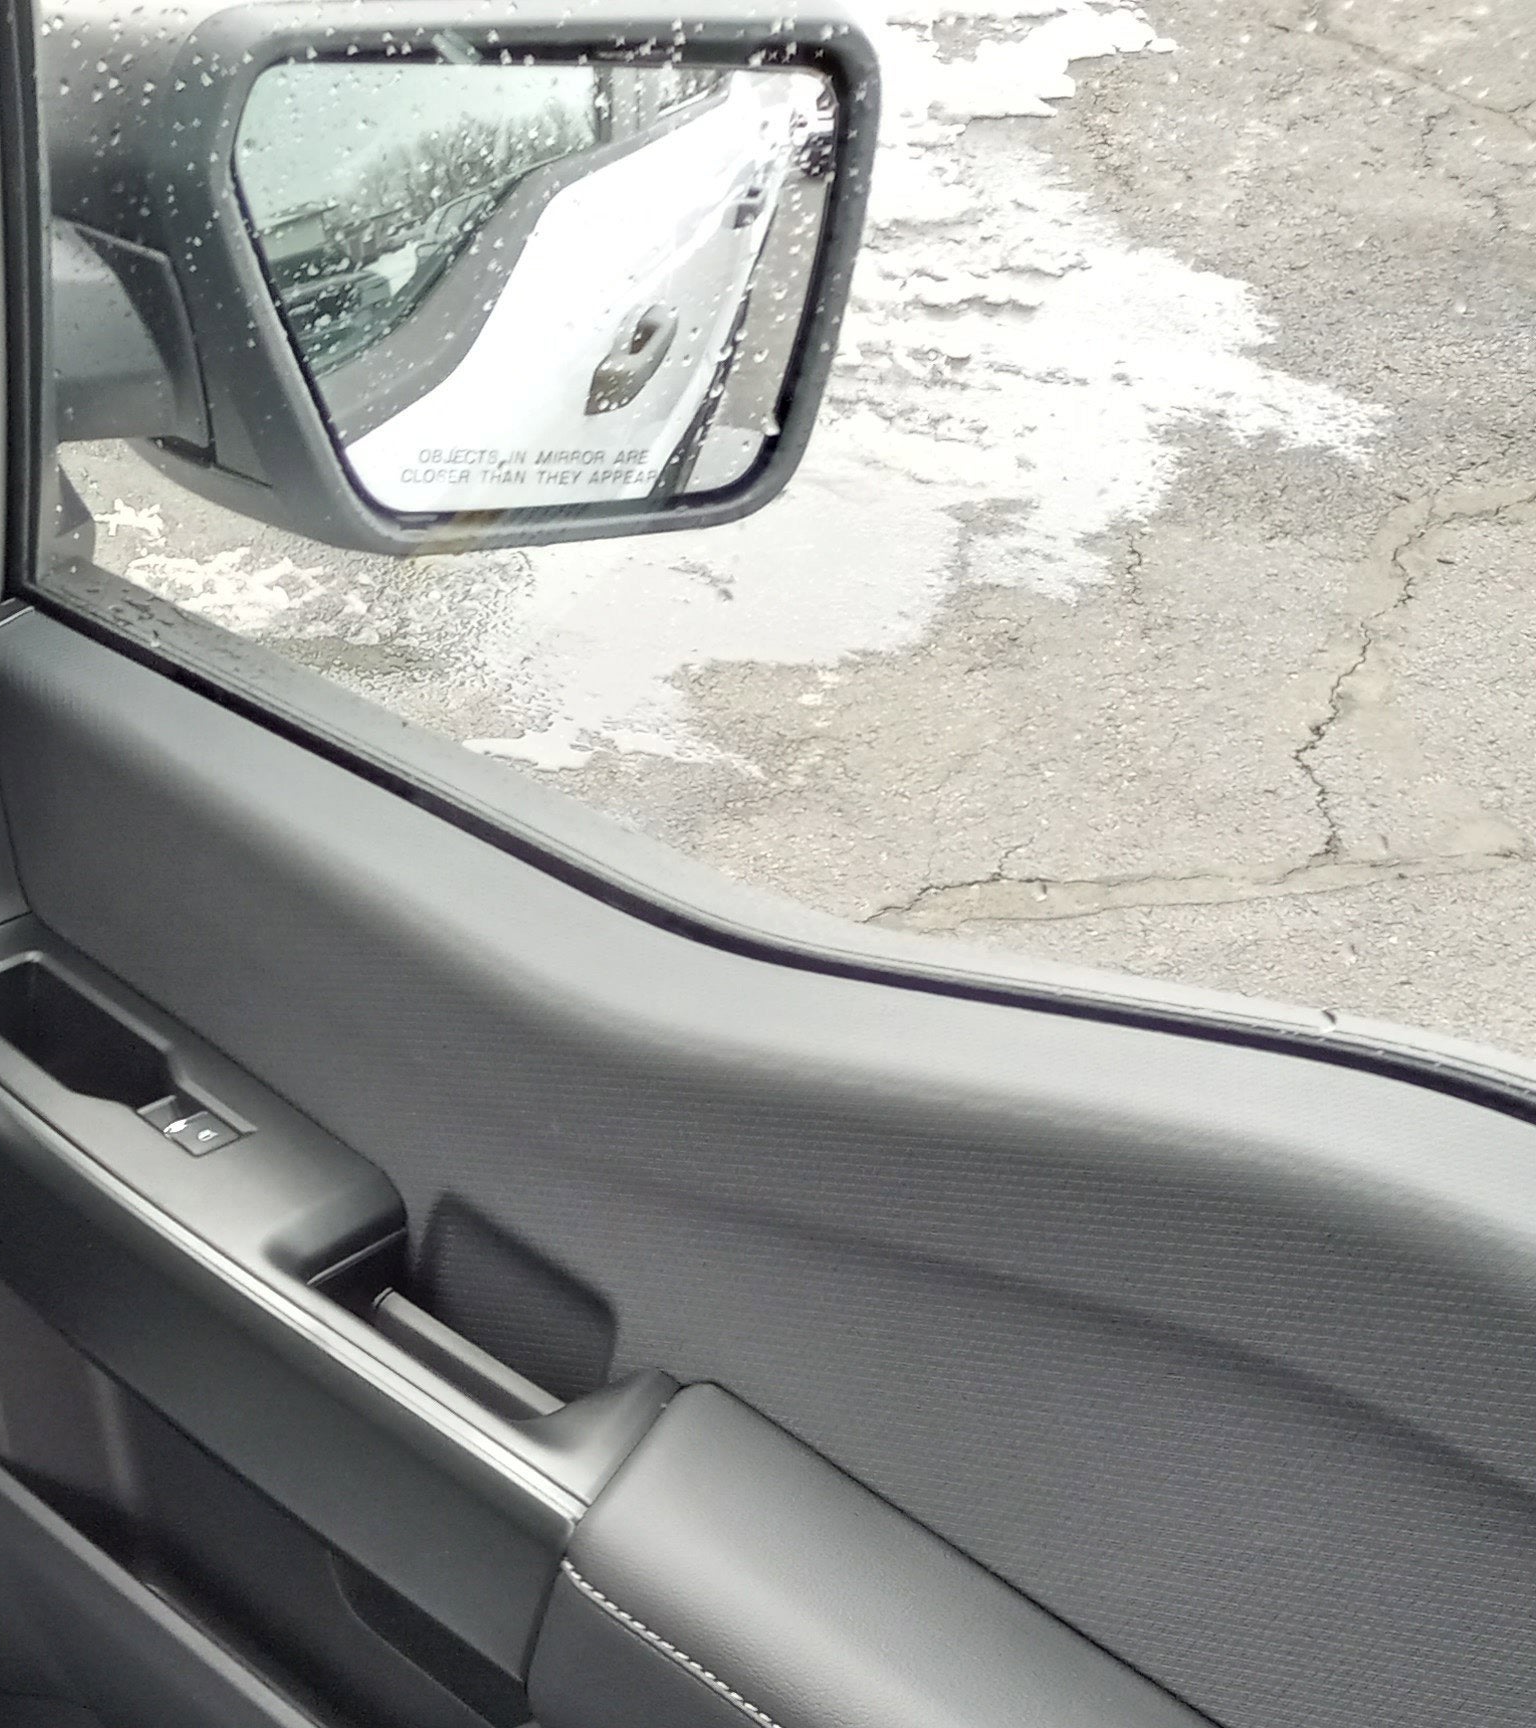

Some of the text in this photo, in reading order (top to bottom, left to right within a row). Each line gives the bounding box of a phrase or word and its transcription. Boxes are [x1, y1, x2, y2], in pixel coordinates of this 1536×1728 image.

[418, 448, 649, 465] OBJECTS IN MIRROR ARE
[400, 468, 659, 485] CLOSER THAN THEY APPEAR
